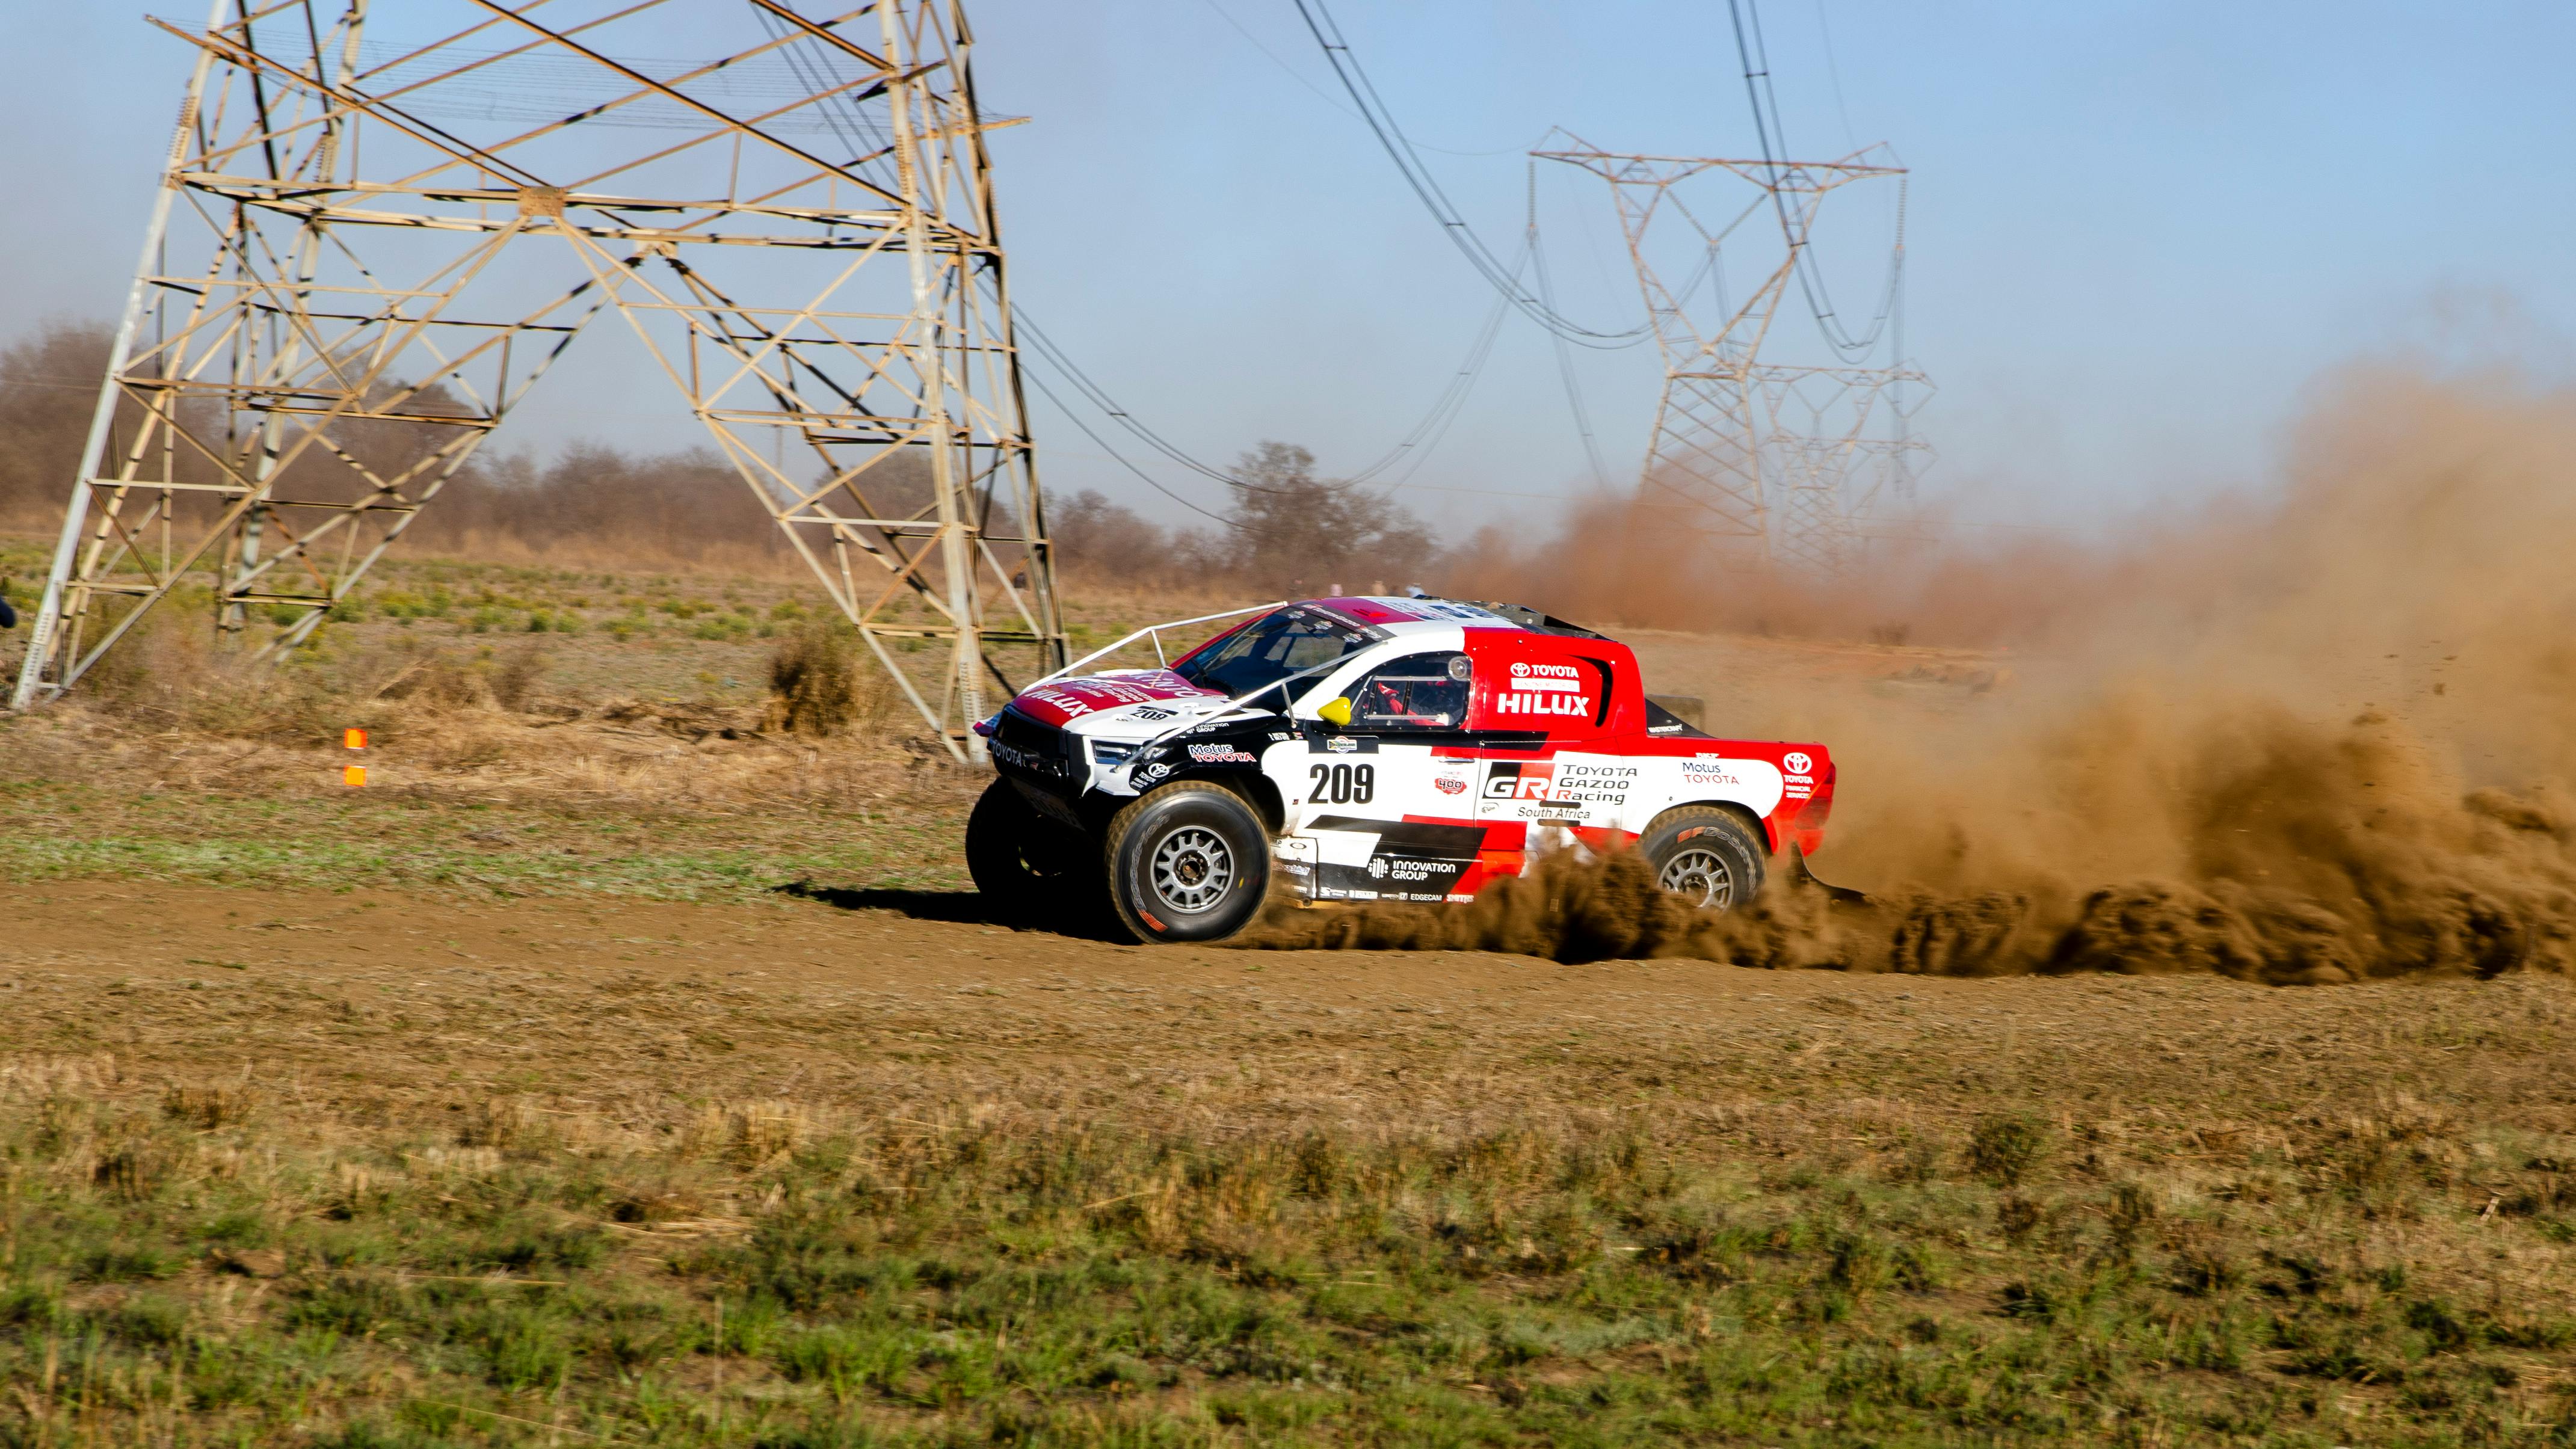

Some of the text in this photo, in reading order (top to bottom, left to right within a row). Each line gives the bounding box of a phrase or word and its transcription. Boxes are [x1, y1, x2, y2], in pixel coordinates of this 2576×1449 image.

[1531, 665, 1579, 678] TOYOTA
[1025, 690, 1095, 717] HILUX
[1497, 693, 1589, 716] HILUX
[1130, 709, 1168, 720] 209
[993, 740, 1021, 767] TOYOTA
[1188, 743, 1234, 754] Motus
[1191, 752, 1257, 762] TOYOTA
[1564, 764, 1638, 777] TOYOTA
[1683, 762, 1721, 773] Motus
[1308, 763, 1374, 804] 209
[1439, 780, 1461, 789] 400
[1559, 778, 1629, 789] GAZOO
[1684, 774, 1739, 784] TOYOTA
[1783, 775, 1814, 784] TOYOTA
[1484, 776, 1550, 799] GR
[1556, 790, 1625, 805] Racing
[1518, 807, 1590, 819] South Africa
[1393, 860, 1456, 873] INNOVATION
[1391, 870, 1428, 881] GROUP
